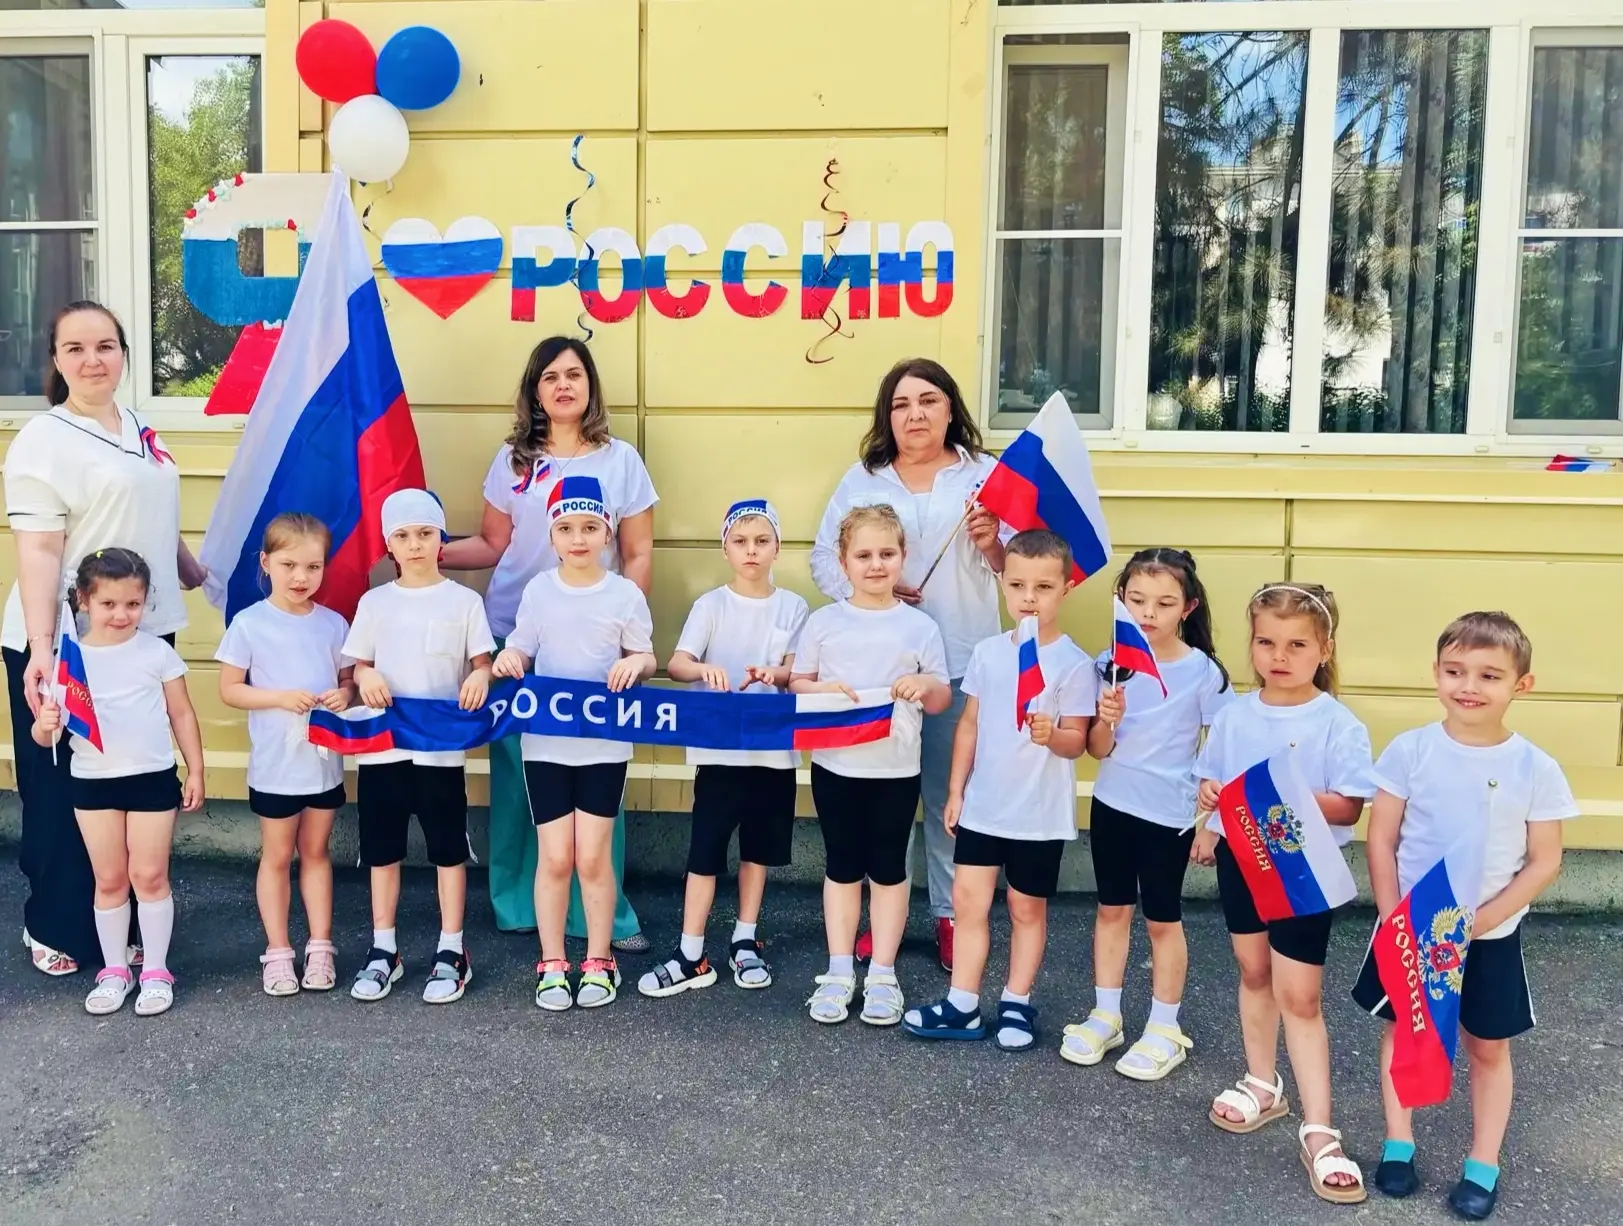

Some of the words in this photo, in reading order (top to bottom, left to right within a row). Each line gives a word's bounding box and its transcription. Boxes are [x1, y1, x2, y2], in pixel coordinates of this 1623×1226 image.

[511, 220, 955, 323] РОССИЮ
[562, 500, 604, 515] РОССИЯ
[489, 687, 677, 732] РОССИЯ
[1236, 805, 1272, 871] РОССИЯ
[1392, 913, 1427, 1034] РОССИЯ
